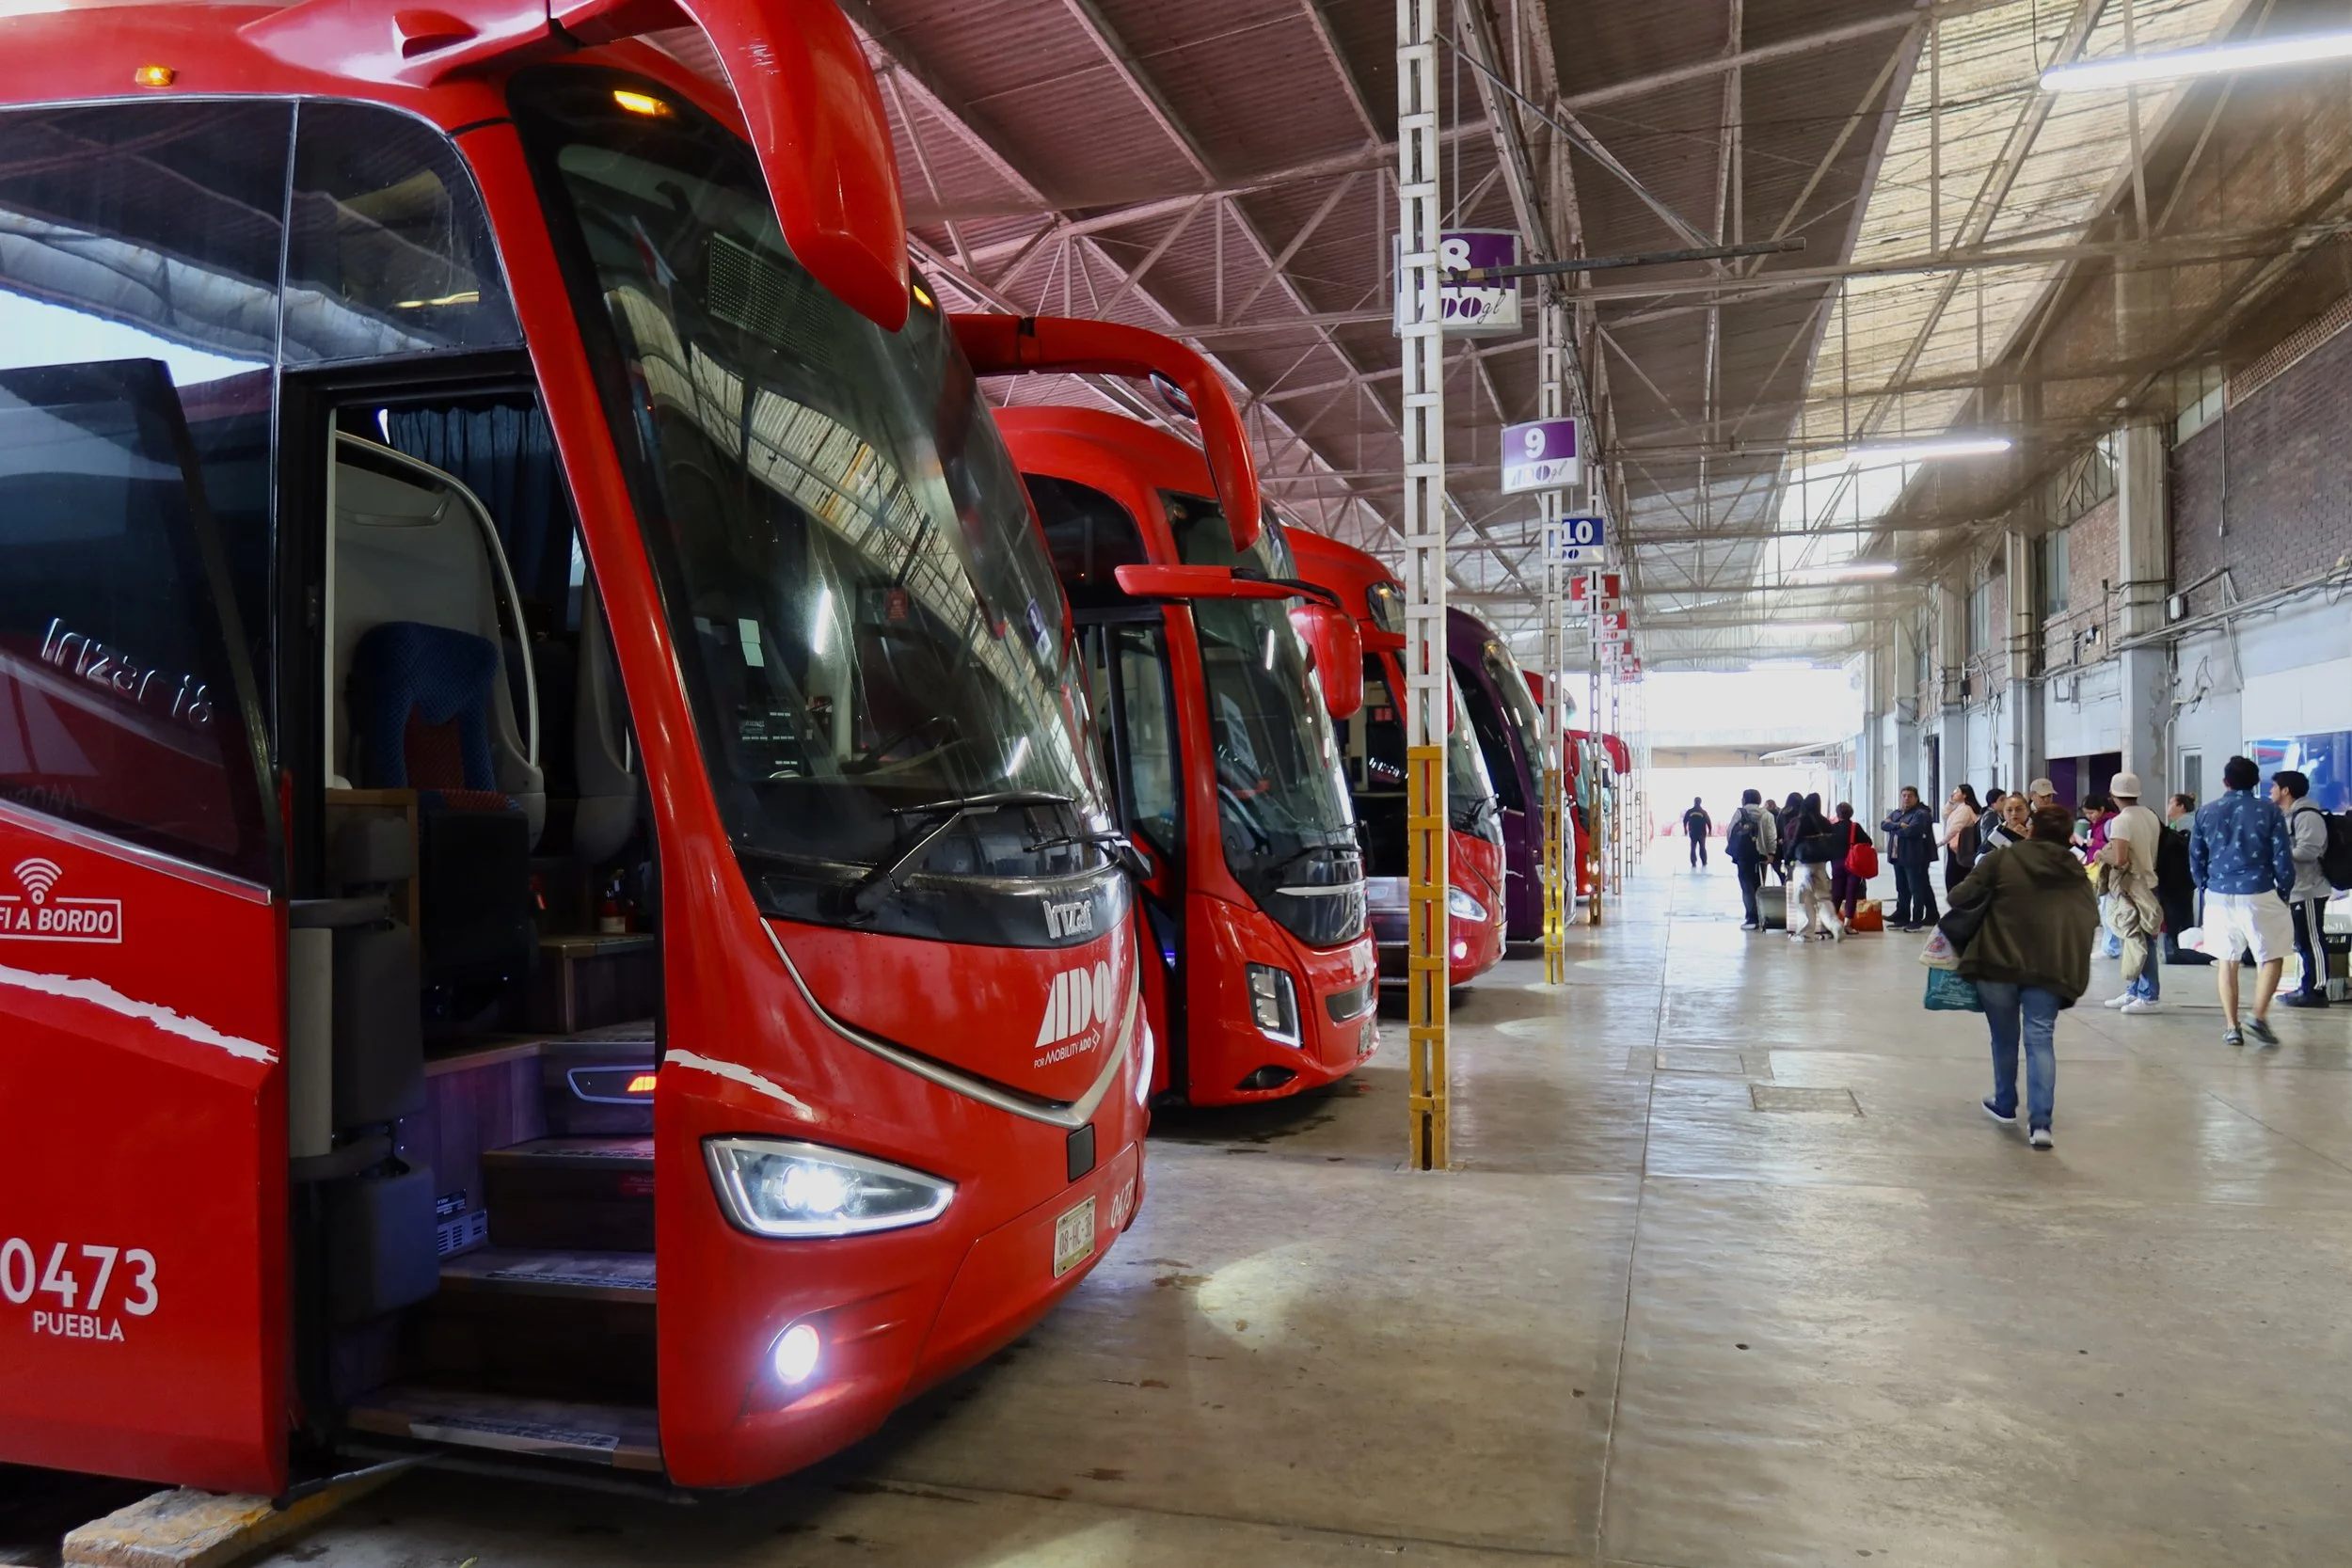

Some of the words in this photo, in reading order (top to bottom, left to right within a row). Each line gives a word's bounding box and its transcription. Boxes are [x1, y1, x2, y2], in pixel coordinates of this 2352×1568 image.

[1439, 238, 1472, 274] 8
[1525, 427, 1546, 459] 9
[1562, 520, 1594, 545] 10
[41, 617, 162, 704] Irizar
[15, 908, 31, 930] A
[38, 908, 114, 934] BORDO
[1035, 959, 1112, 1048] ADO
[1034, 1057, 1045, 1069] POR
[1044, 1041, 1078, 1066] MOBILITY
[1079, 1036, 1092, 1053] ADO
[0, 1237, 159, 1317] 0473
[33, 1310, 125, 1342] PUEBLA
